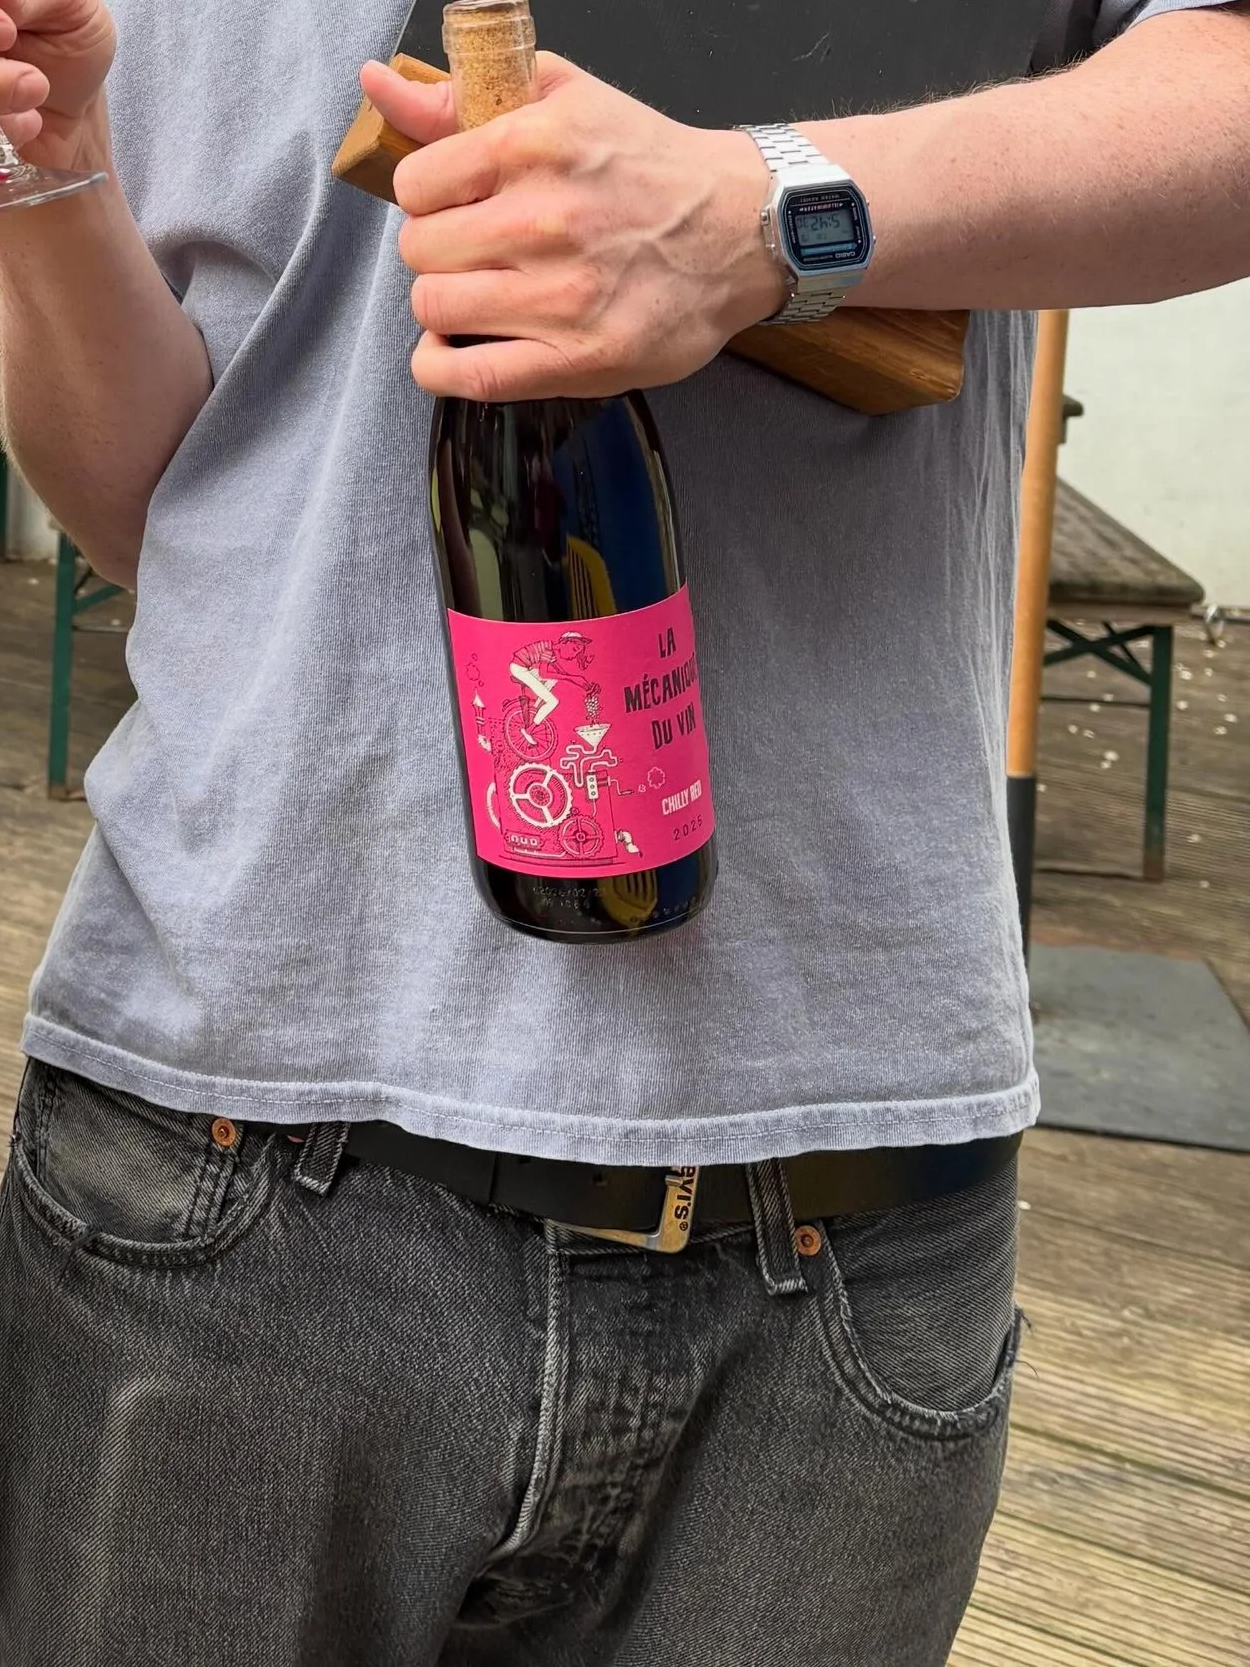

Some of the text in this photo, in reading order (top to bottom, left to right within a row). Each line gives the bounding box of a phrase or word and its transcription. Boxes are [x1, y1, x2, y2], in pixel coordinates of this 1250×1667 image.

[658, 627, 676, 659] LA
[652, 702, 697, 751] DU VIN
[661, 779, 703, 816] CHILLY RED
